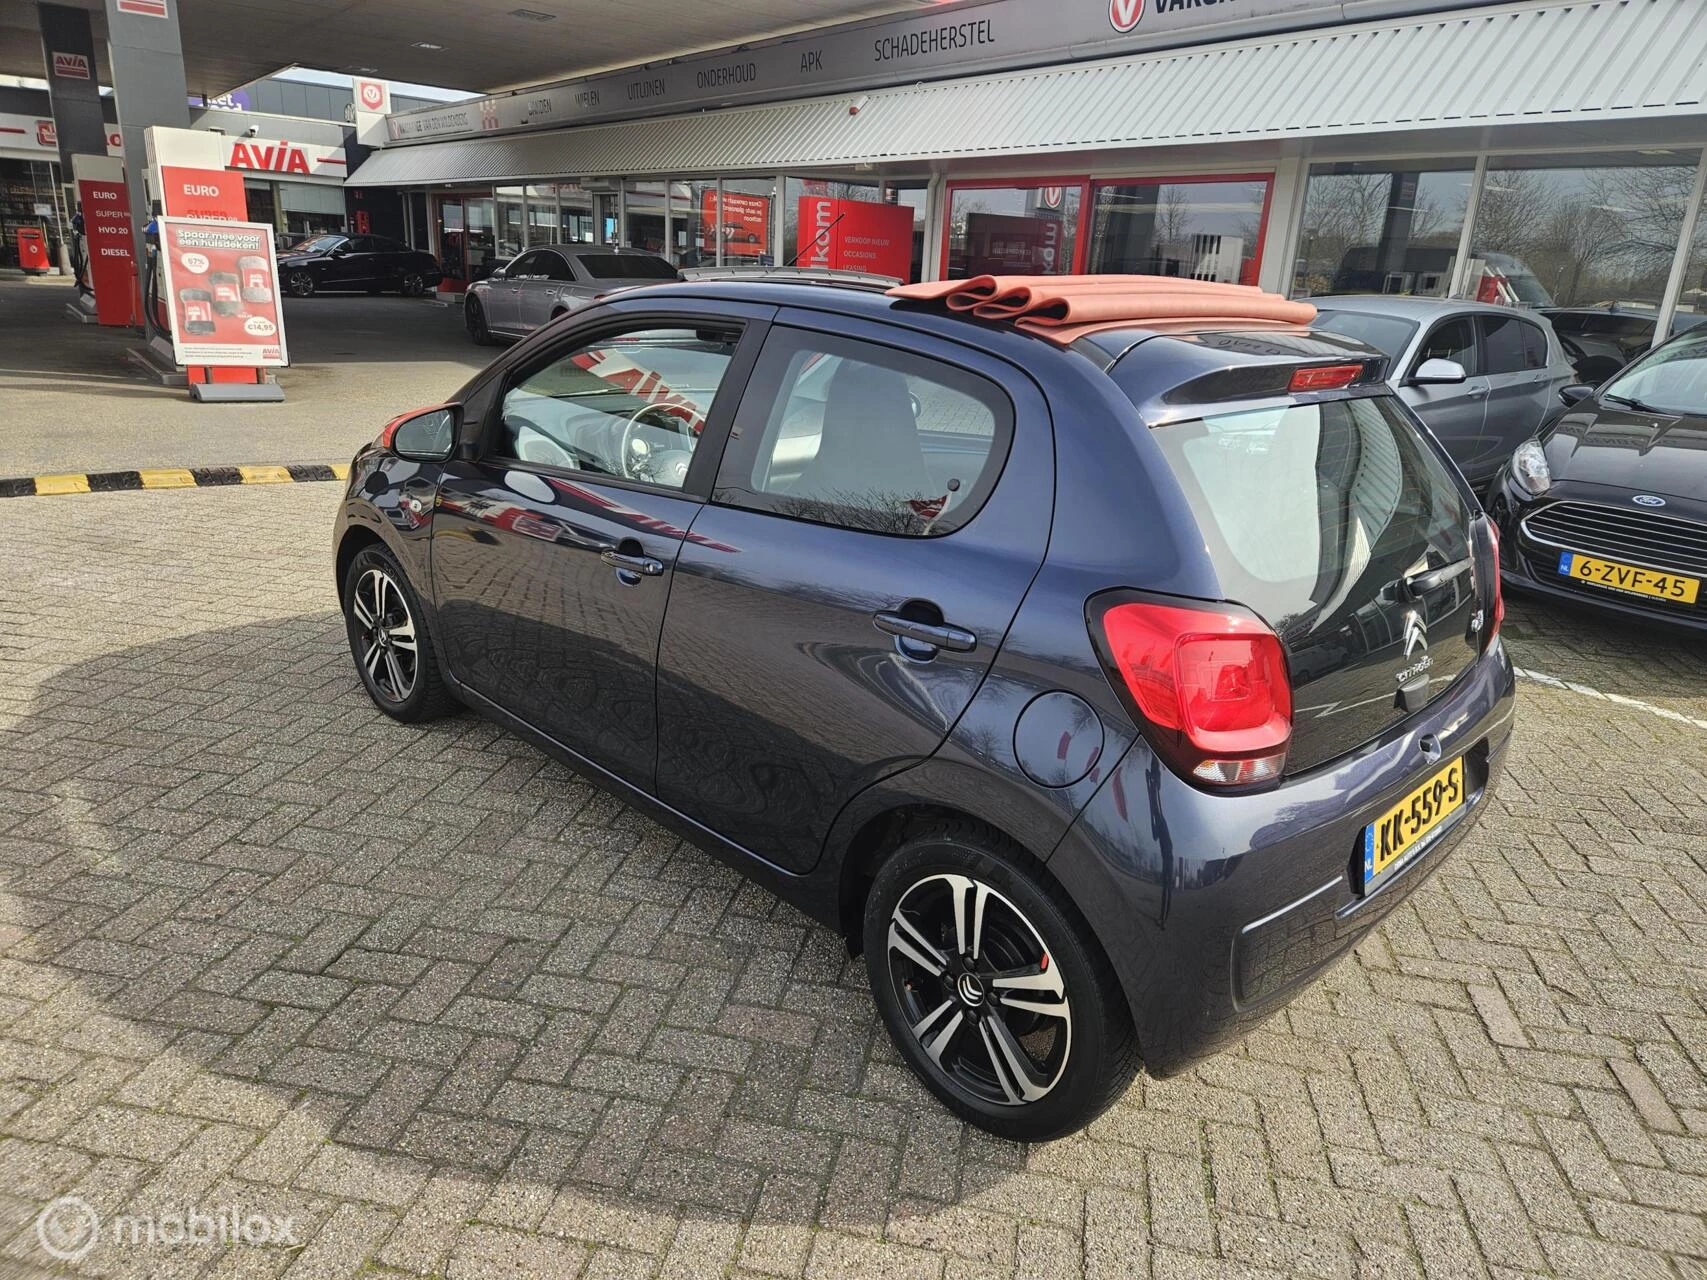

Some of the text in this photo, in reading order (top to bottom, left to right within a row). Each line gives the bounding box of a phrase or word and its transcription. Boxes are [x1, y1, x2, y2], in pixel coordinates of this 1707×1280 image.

[873, 19, 996, 62] SCHADEHERSTEL
[55, 55, 88, 69] AVIA
[800, 50, 823, 74] APK
[696, 63, 757, 89] ONDERHOUD
[229, 140, 311, 176] AVIA
[92, 191, 117, 200] EURO
[183, 184, 220, 197] EURO
[96, 210, 123, 219] SUPER
[98, 226, 128, 235] HVO 20
[177, 229, 261, 242] Spaar mee voor
[178, 238, 260, 250] een huisdeken!
[101, 248, 130, 257] DIESEL
[247, 323, 274, 332] €14,95
[1560, 564, 1569, 573] NL
[1579, 560, 1686, 598] 6-ZVF-45
[1364, 858, 1373, 871] NL
[1379, 767, 1459, 862] KK-559-S
